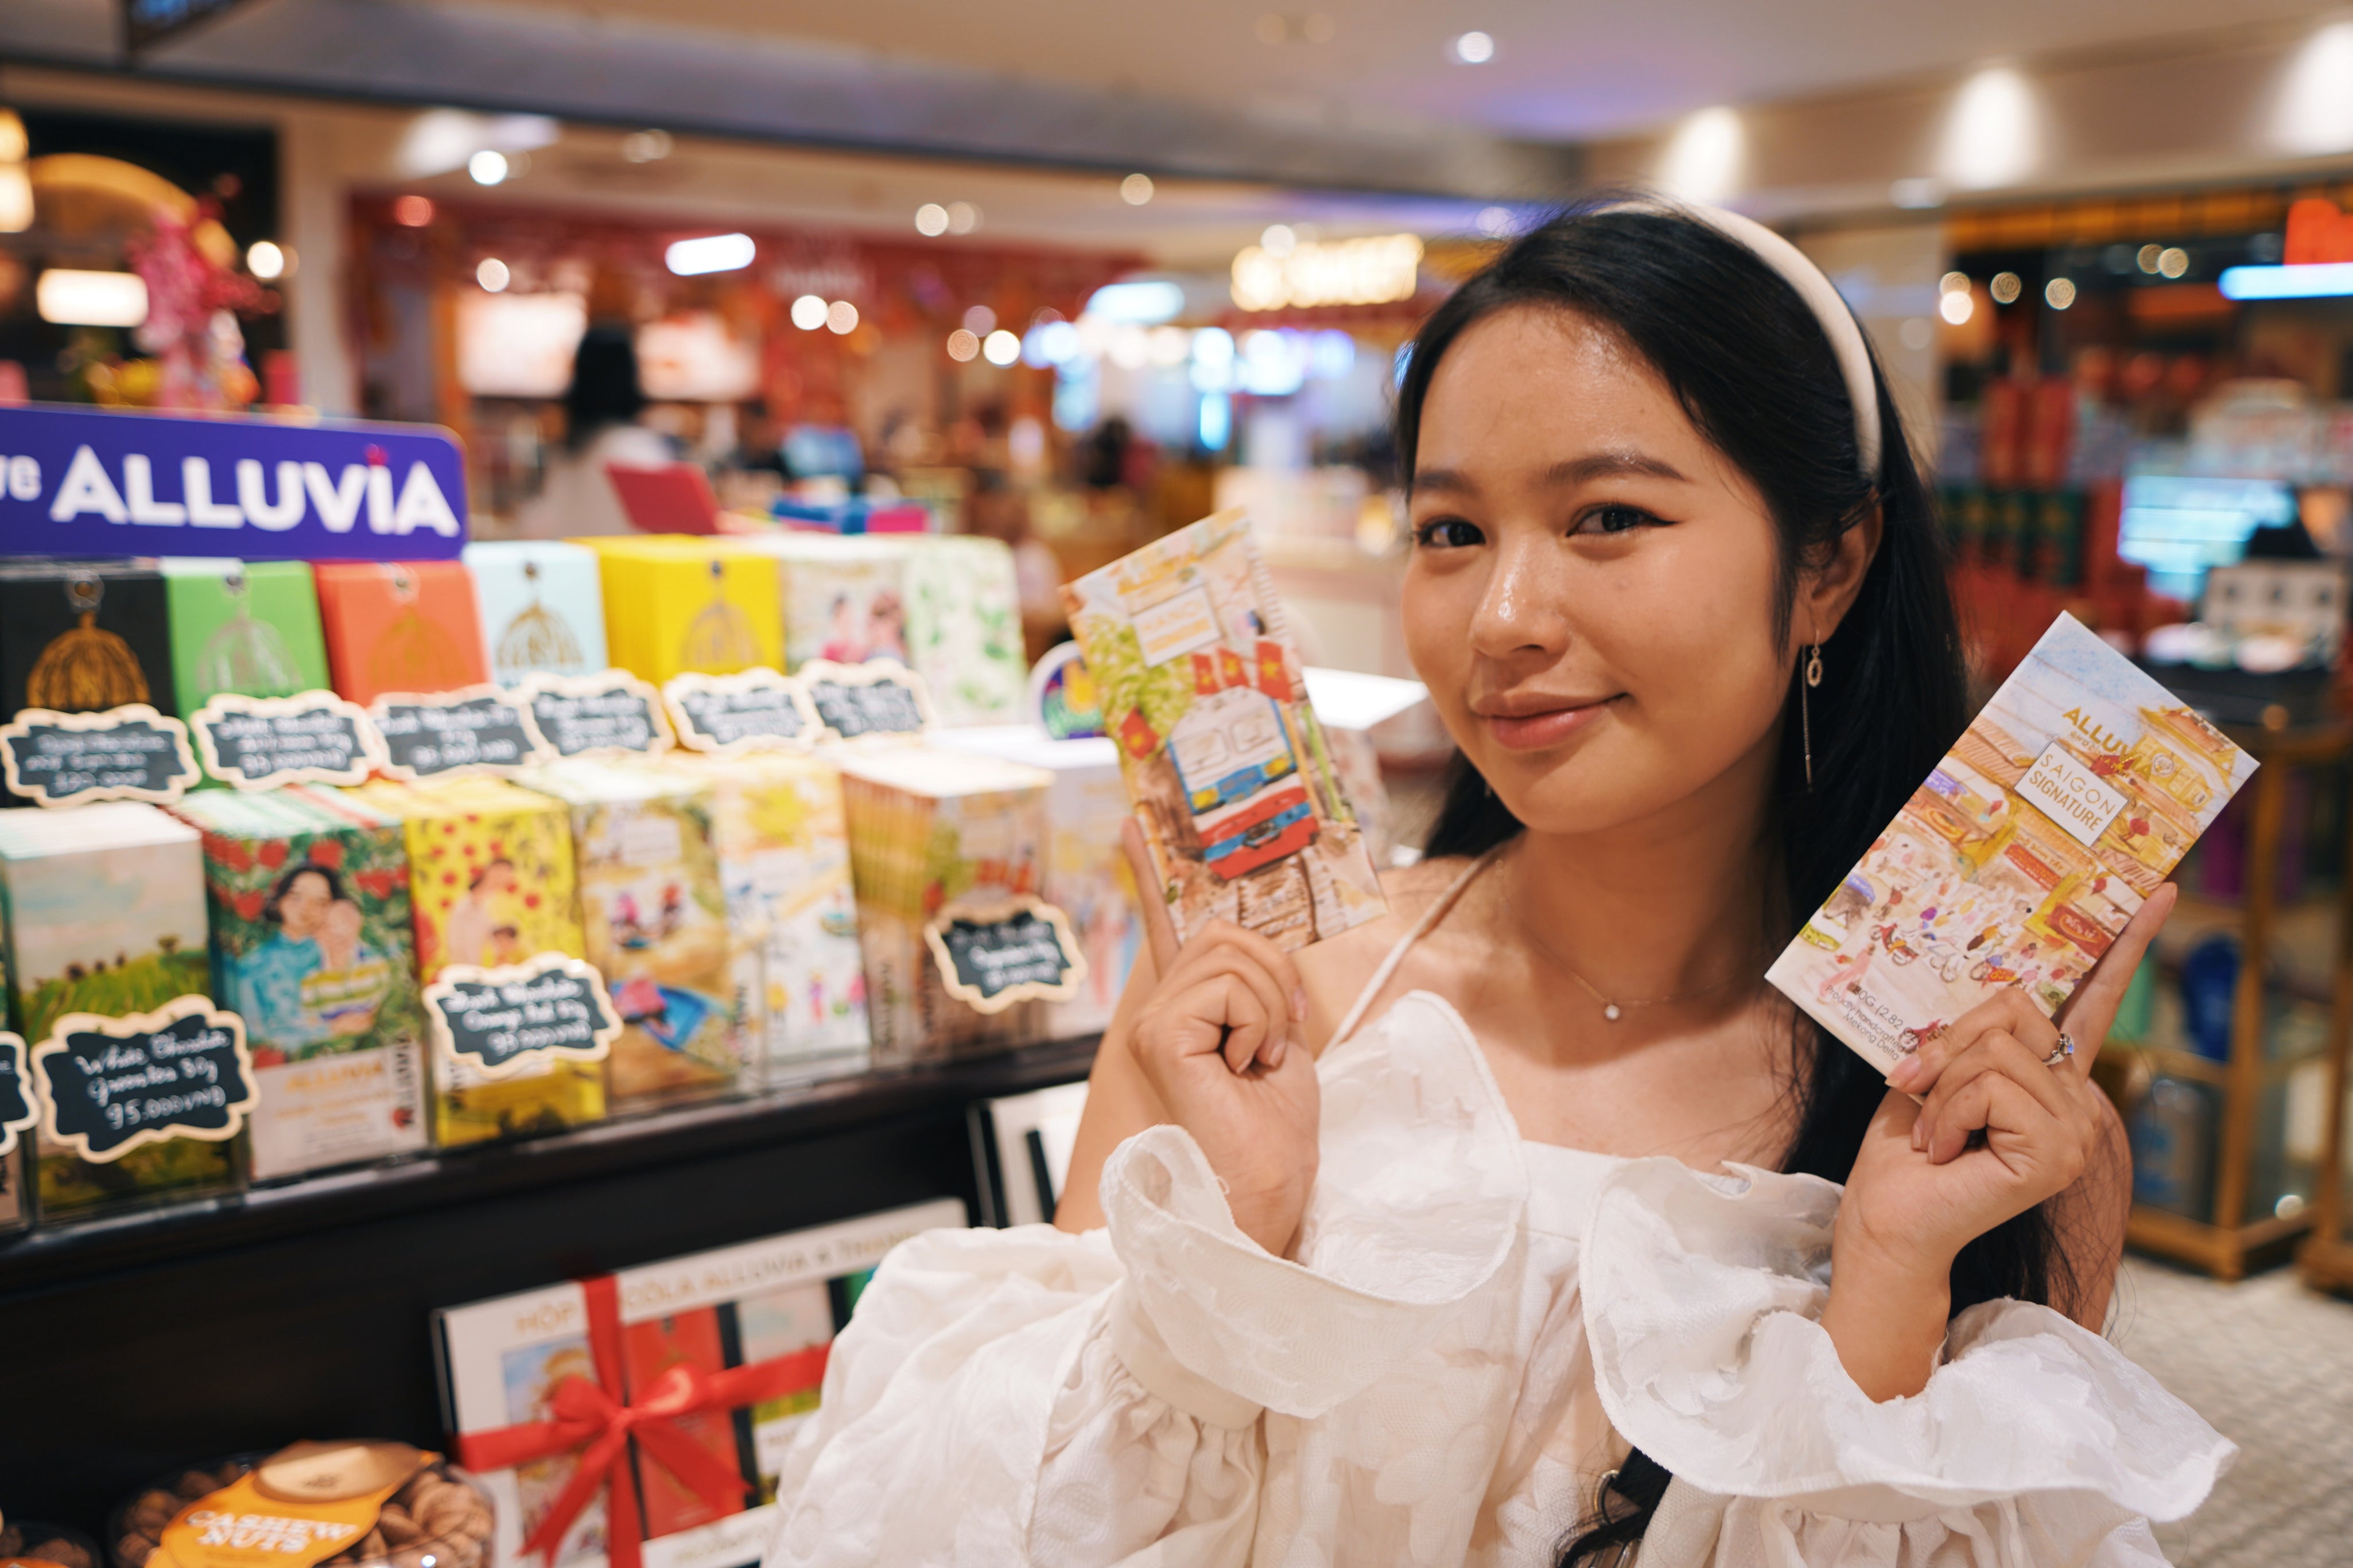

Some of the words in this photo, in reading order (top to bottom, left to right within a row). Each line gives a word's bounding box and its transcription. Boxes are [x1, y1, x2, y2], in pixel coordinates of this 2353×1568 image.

[49, 443, 461, 538] ALLUVIA
[2061, 706, 2152, 782] ALLUVIA
[2029, 771, 2103, 831] SIGNATURE
[2040, 754, 2116, 816] SAIGON
[1825, 985, 1856, 1011] Proudly
[1854, 1007, 1908, 1053] handcrafted
[1843, 1013, 1877, 1044] Mekong
[1877, 1038, 1900, 1061] Delta
[1874, 1004, 1904, 1030] (2.82
[187, 1509, 360, 1542] CASHEW
[196, 1525, 311, 1555] NUTS
